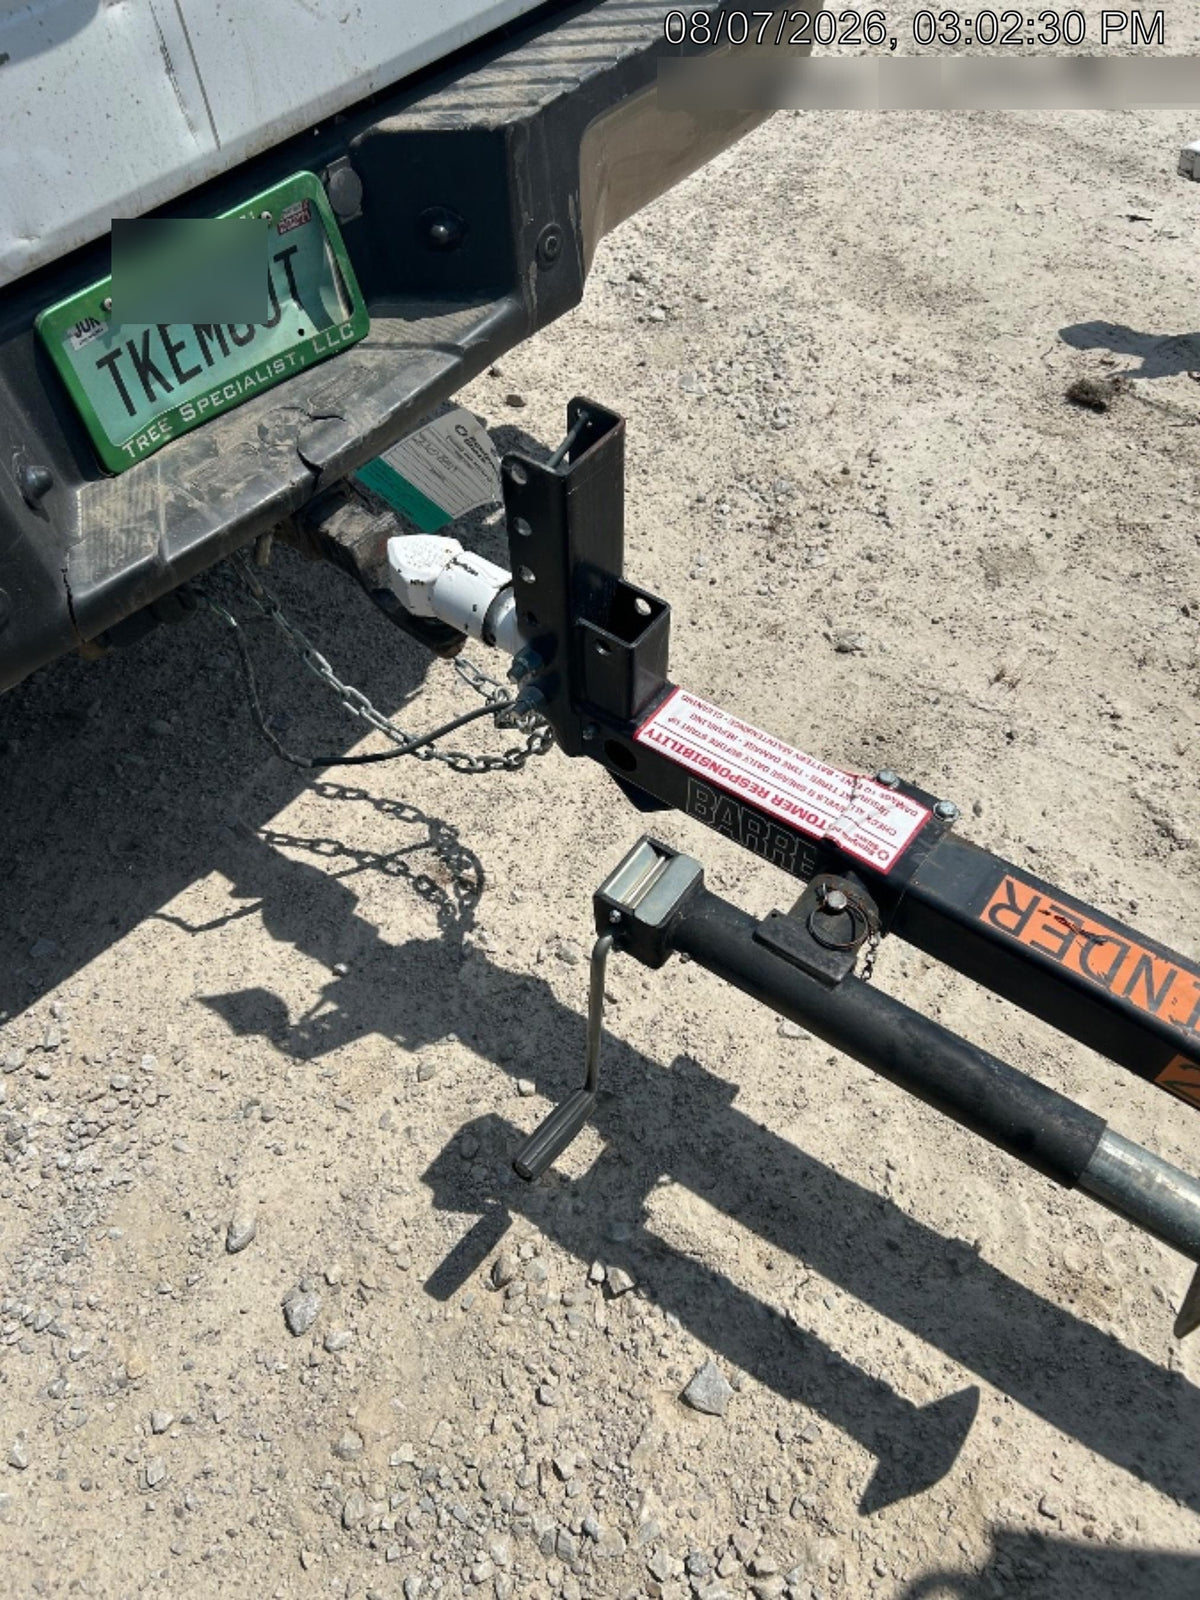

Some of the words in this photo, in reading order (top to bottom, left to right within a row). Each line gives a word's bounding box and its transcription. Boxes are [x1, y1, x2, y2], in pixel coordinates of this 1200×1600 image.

[122, 416, 174, 458] TREE
[312, 323, 356, 354] LLC
[679, 693, 725, 720] CLEANING
[666, 715, 681, 726] UP
[679, 722, 709, 741] START
[707, 737, 744, 759] BEFORE
[741, 739, 782, 764] DAMAGE
[642, 726, 771, 800] RESPONSIBILITY
[741, 754, 771, 773] DAILY
[768, 793, 831, 831] TOMER
[875, 790, 921, 817] DAMAGE
[861, 814, 898, 837] CHECK
